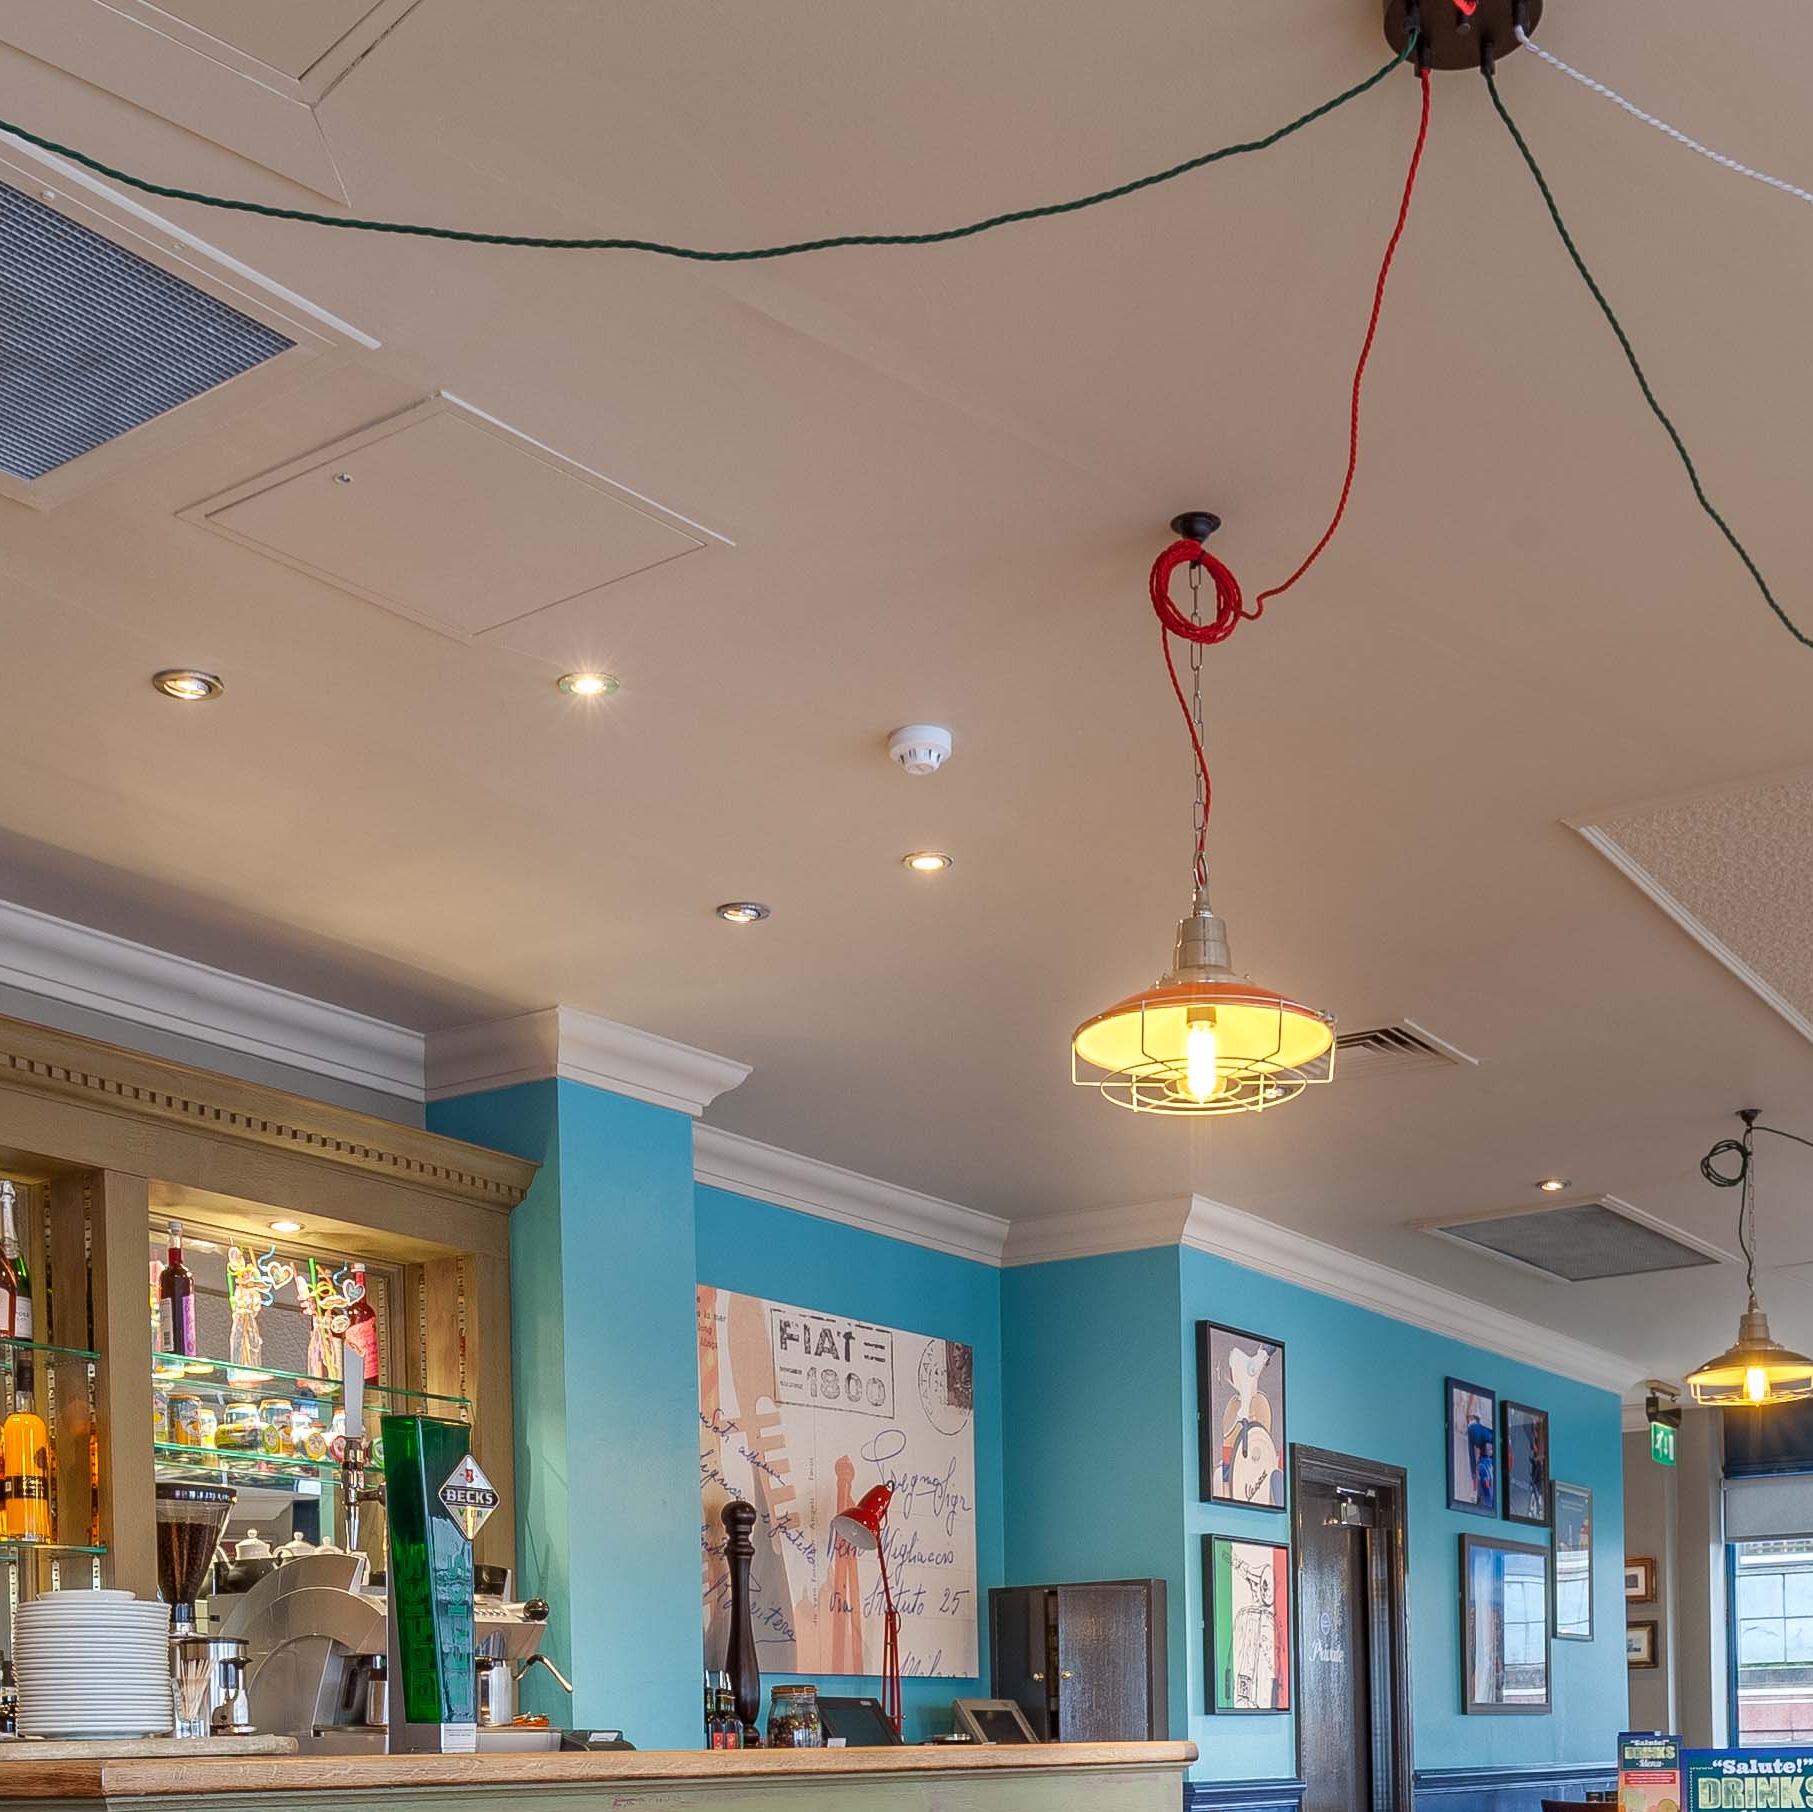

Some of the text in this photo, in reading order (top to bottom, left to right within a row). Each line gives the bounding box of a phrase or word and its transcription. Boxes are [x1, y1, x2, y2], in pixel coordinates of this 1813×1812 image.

[779, 1318, 856, 1363] FIAT
[807, 1366, 886, 1407] 1800
[446, 1488, 494, 1505] BECK'S
[939, 1589, 971, 1615] 25
[1712, 1758, 1813, 1775] “Salute!”
